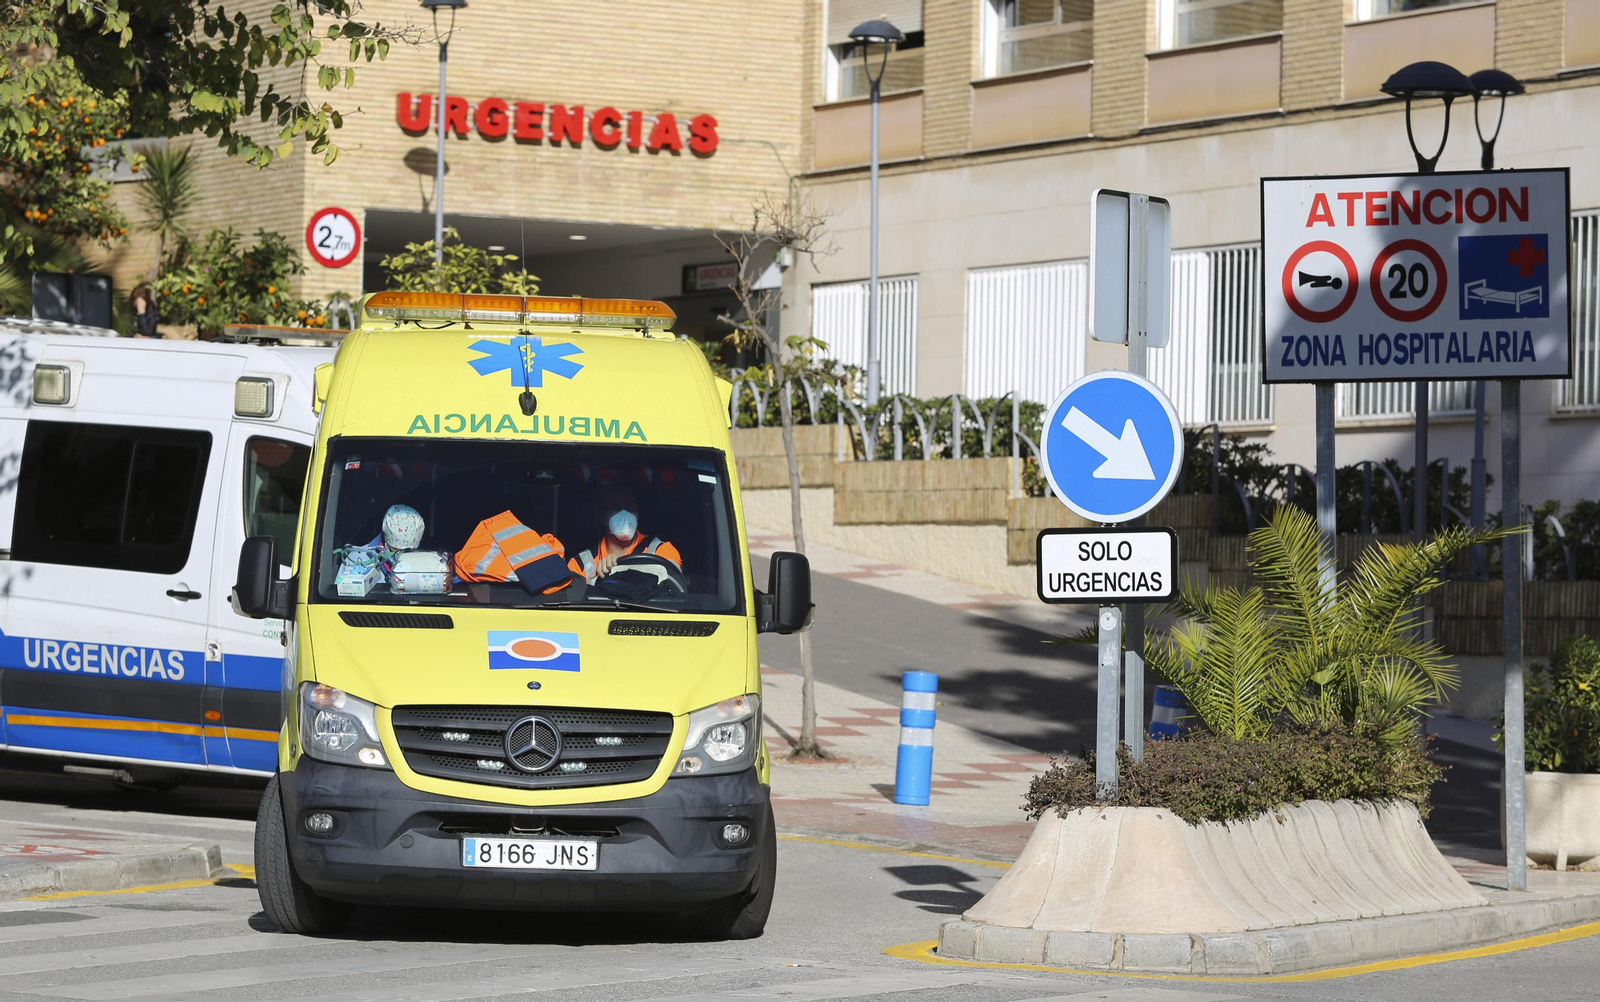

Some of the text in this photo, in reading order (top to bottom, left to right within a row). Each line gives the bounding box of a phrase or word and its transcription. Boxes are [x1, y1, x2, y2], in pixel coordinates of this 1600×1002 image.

[396, 92, 719, 154] URGENCIAS
[1305, 186, 1530, 227] ATENCION
[1387, 262, 1429, 299] 20
[1281, 330, 1537, 367] ZONA HOSPITALARIA
[1078, 540, 1133, 562] SOLO
[1048, 571, 1163, 593] URGENCIAS
[23, 638, 186, 681] URGENCIAS
[479, 842, 535, 864] 8166
[546, 844, 589, 866] JNS
